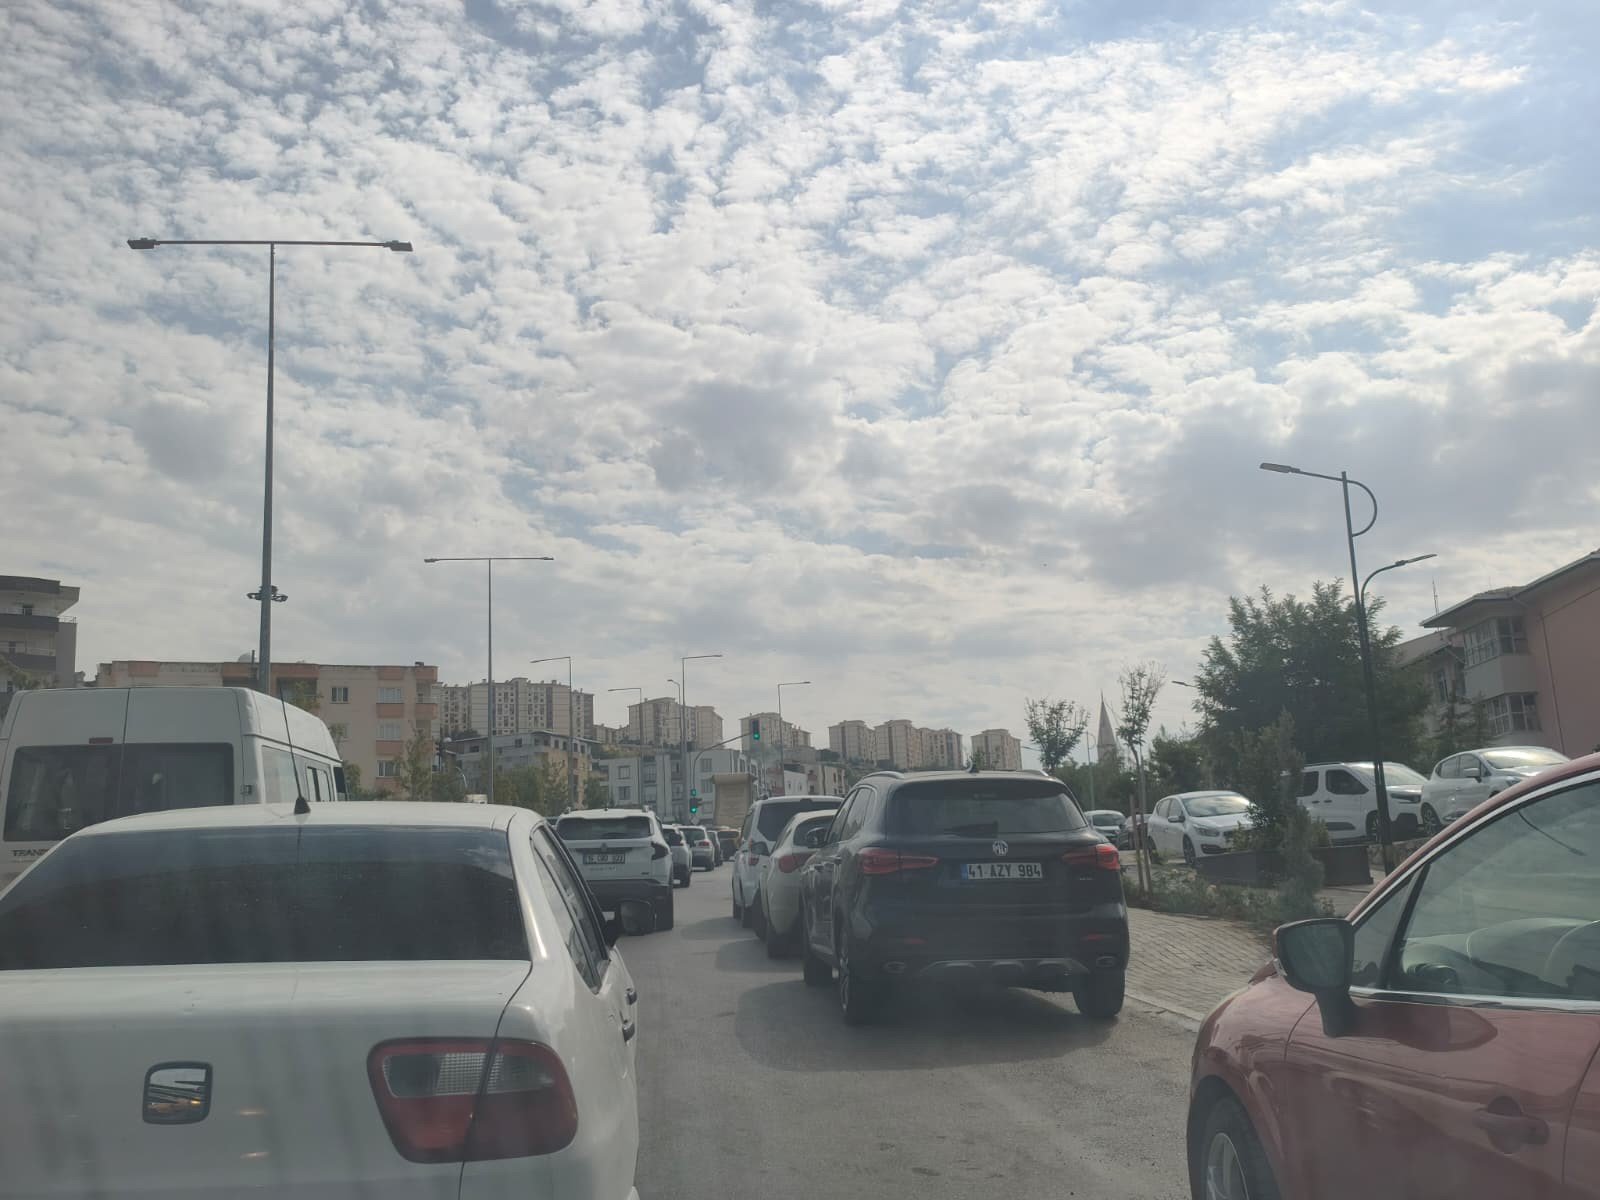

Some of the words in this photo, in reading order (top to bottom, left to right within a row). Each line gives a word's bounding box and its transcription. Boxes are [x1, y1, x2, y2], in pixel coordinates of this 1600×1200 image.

[968, 865, 983, 878] 41
[990, 864, 1011, 877] AZY
[1018, 864, 1040, 877] 984
